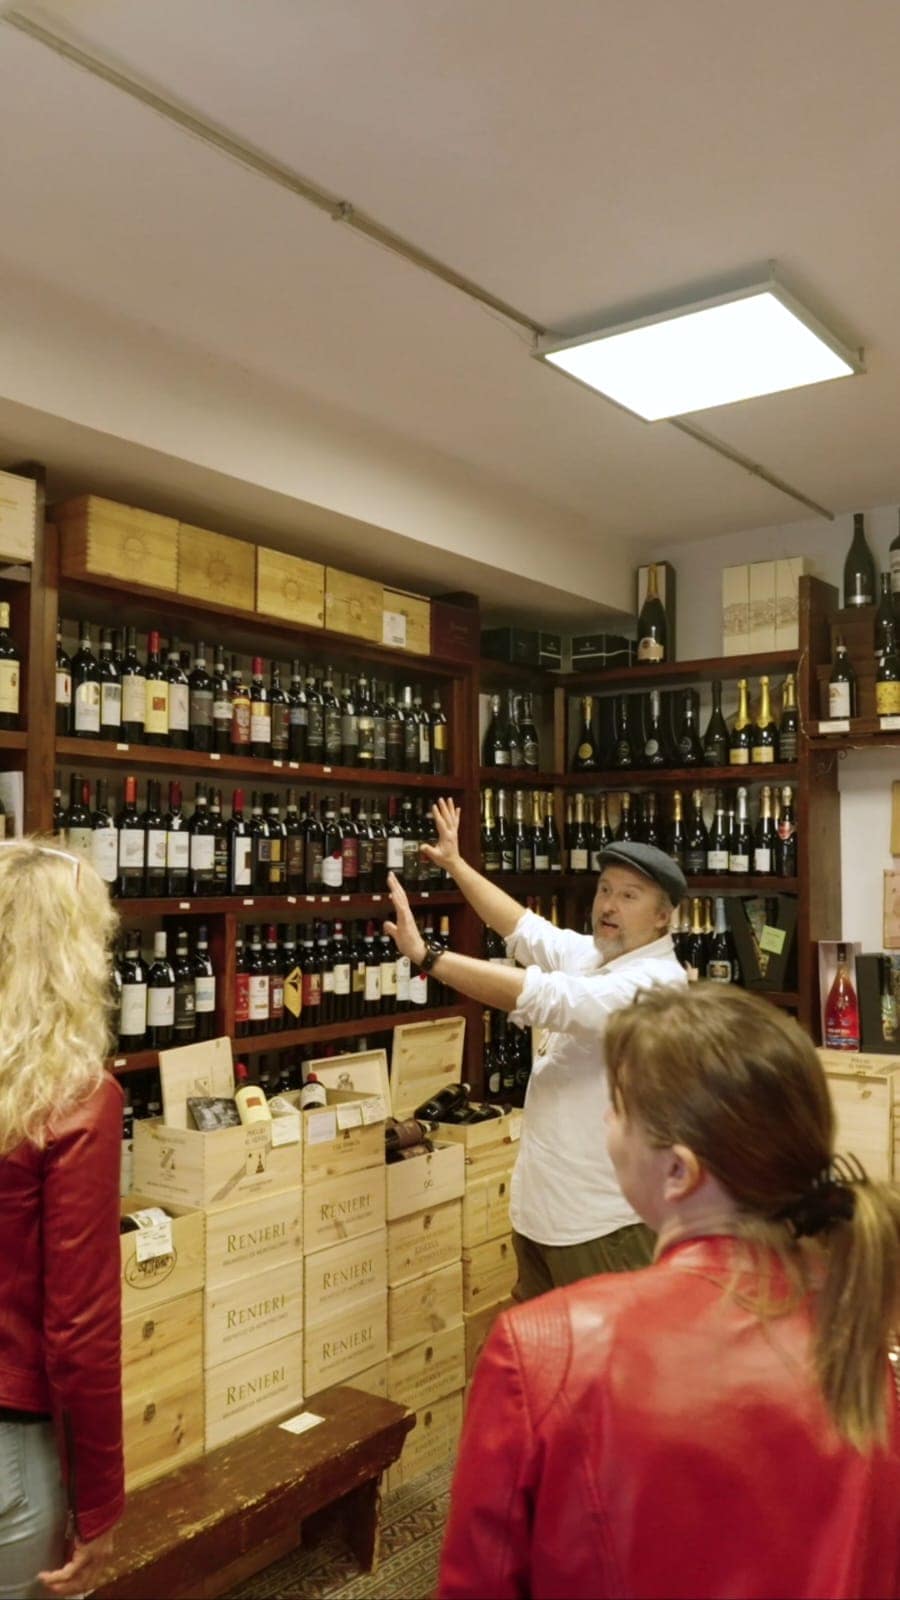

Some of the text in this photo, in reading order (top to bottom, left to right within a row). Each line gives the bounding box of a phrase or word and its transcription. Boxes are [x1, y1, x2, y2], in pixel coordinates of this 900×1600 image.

[321, 1192, 370, 1221] RENIERI
[228, 1221, 286, 1253] RENIERI
[323, 1259, 373, 1290] RENIERI
[227, 1294, 285, 1329] RENIERI
[322, 1326, 373, 1360] RENIERI
[227, 1366, 285, 1405] RENIERI
